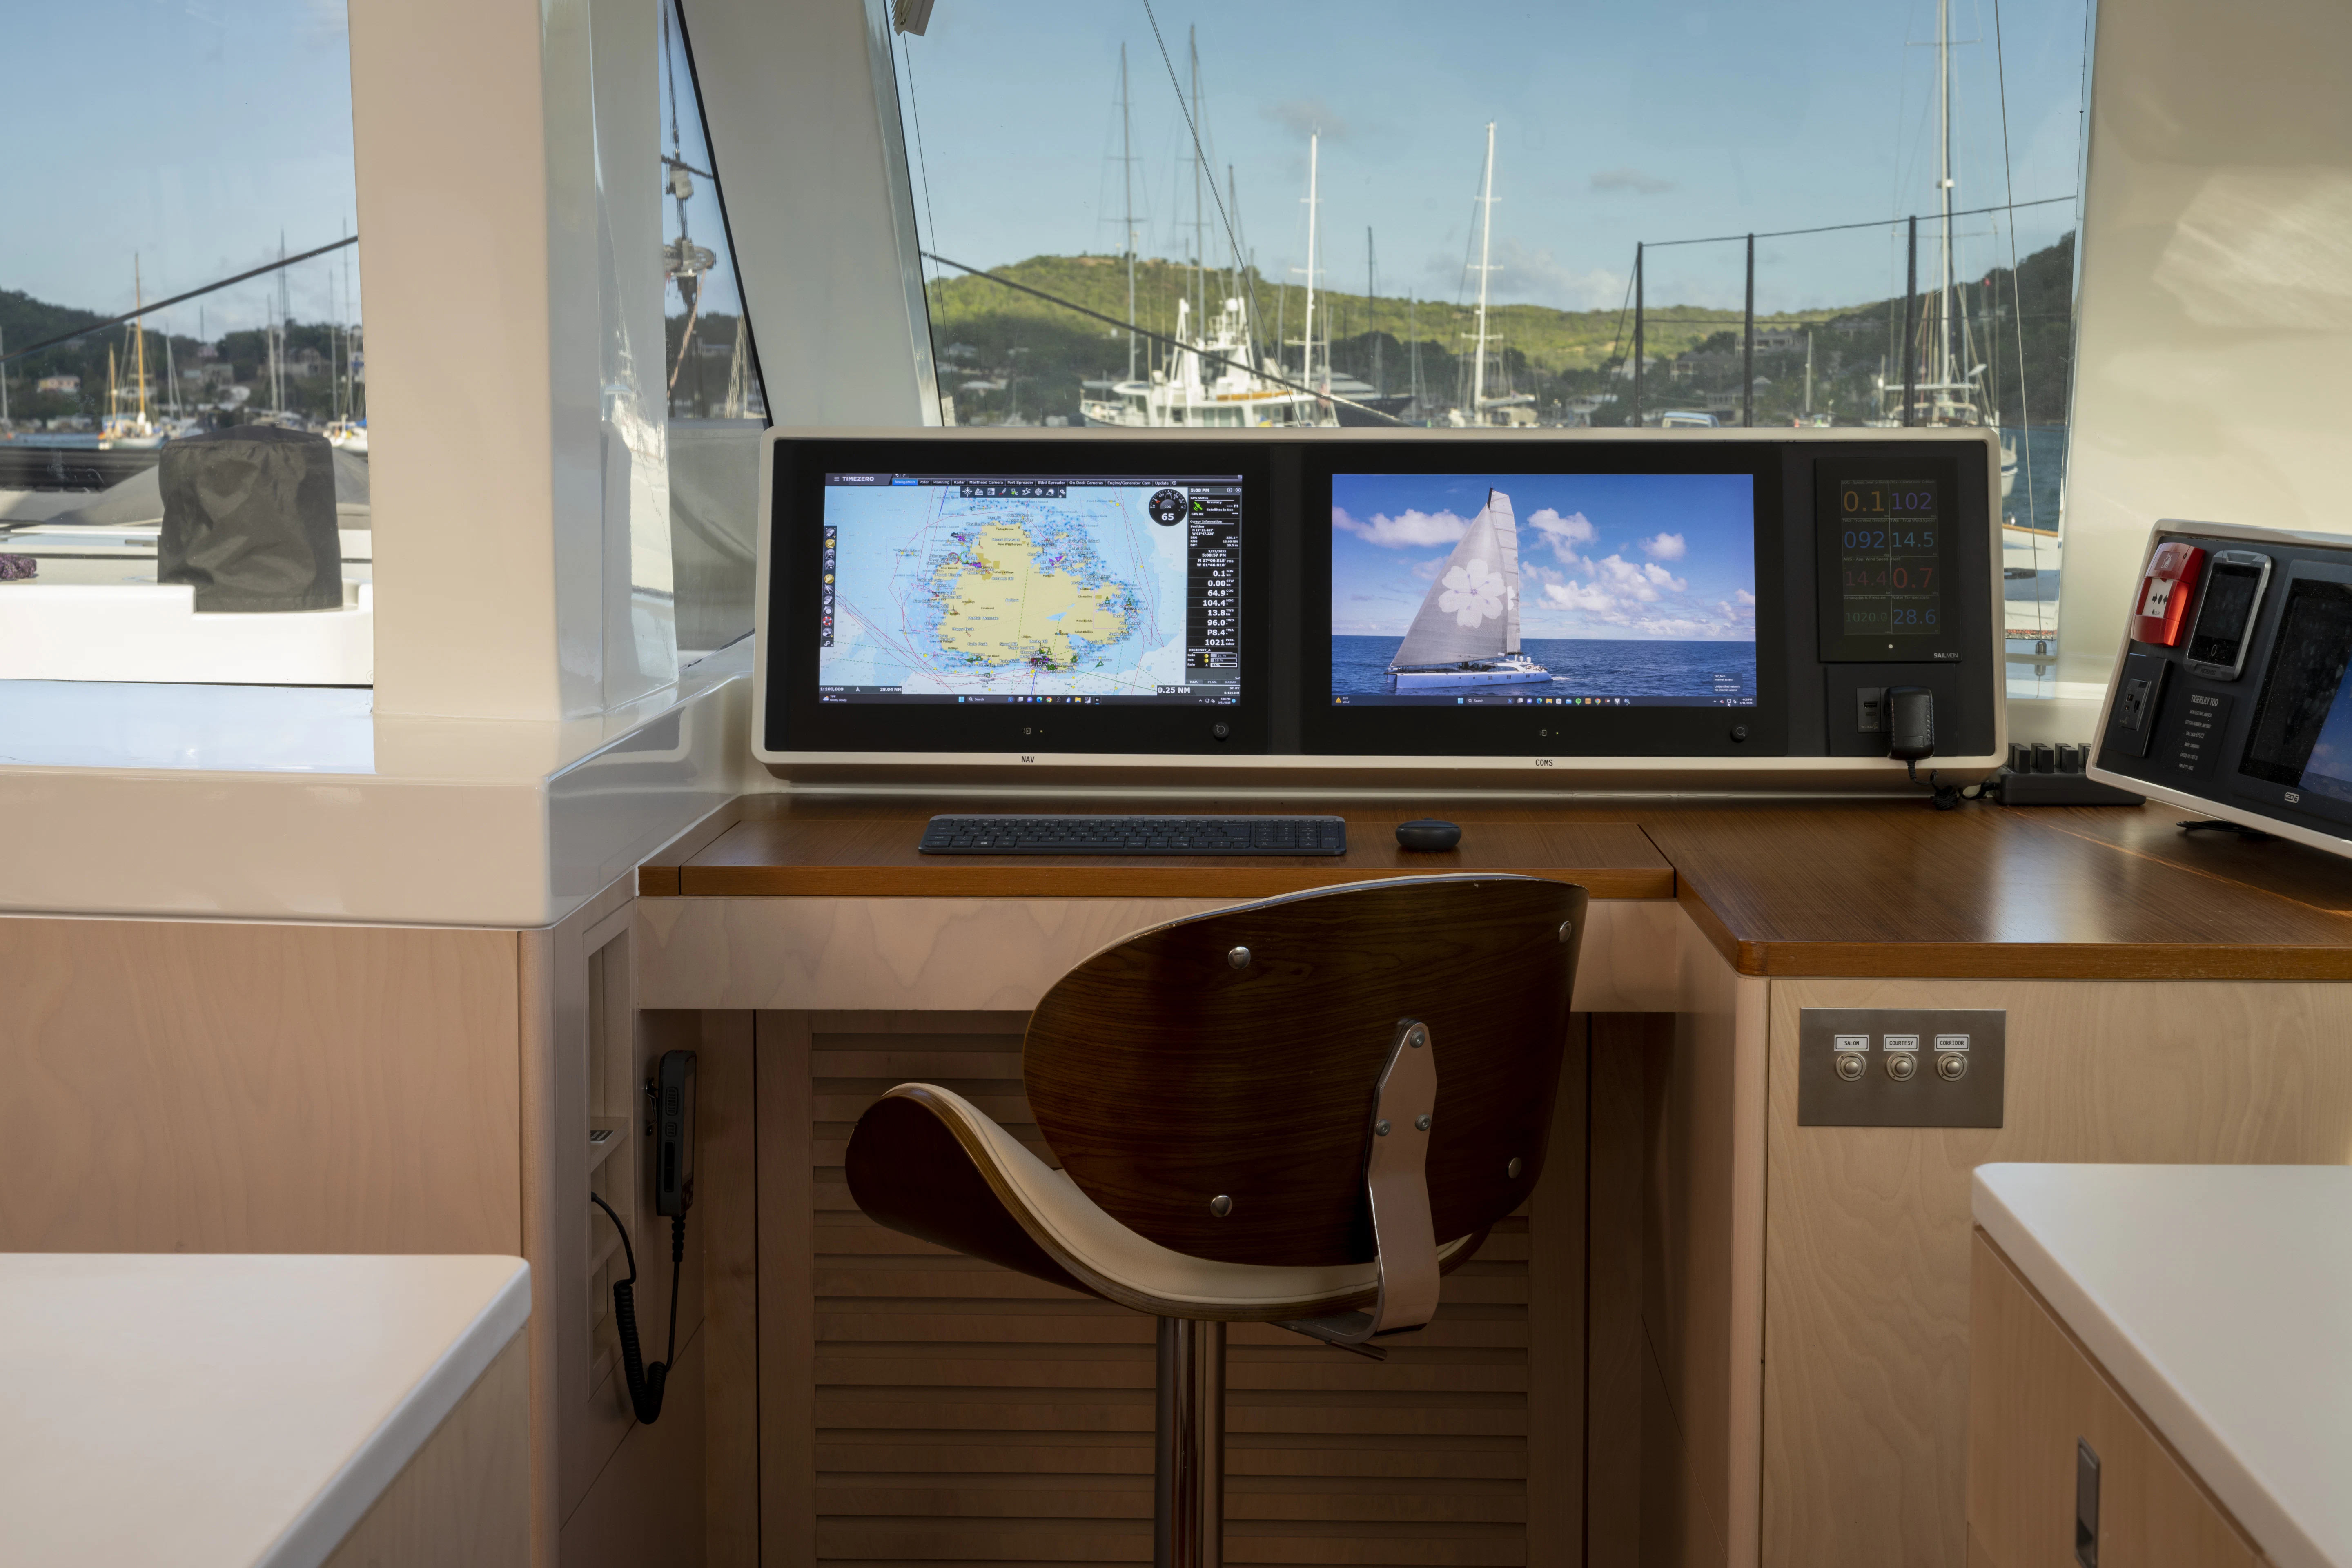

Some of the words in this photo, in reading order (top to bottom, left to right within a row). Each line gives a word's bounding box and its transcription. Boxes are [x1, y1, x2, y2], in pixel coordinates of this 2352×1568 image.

[1844, 491, 1884, 512] 0.1
[1892, 492, 1931, 510] 102
[1844, 531, 1884, 548] 092
[1892, 532, 1934, 548] 14.5
[1846, 571, 1887, 586] 14.4
[1893, 568, 1933, 588] 0.7
[1894, 609, 1936, 624] 28.6
[2191, 695, 2210, 705] TIGERLILY
[2210, 698, 2218, 706] TOO
